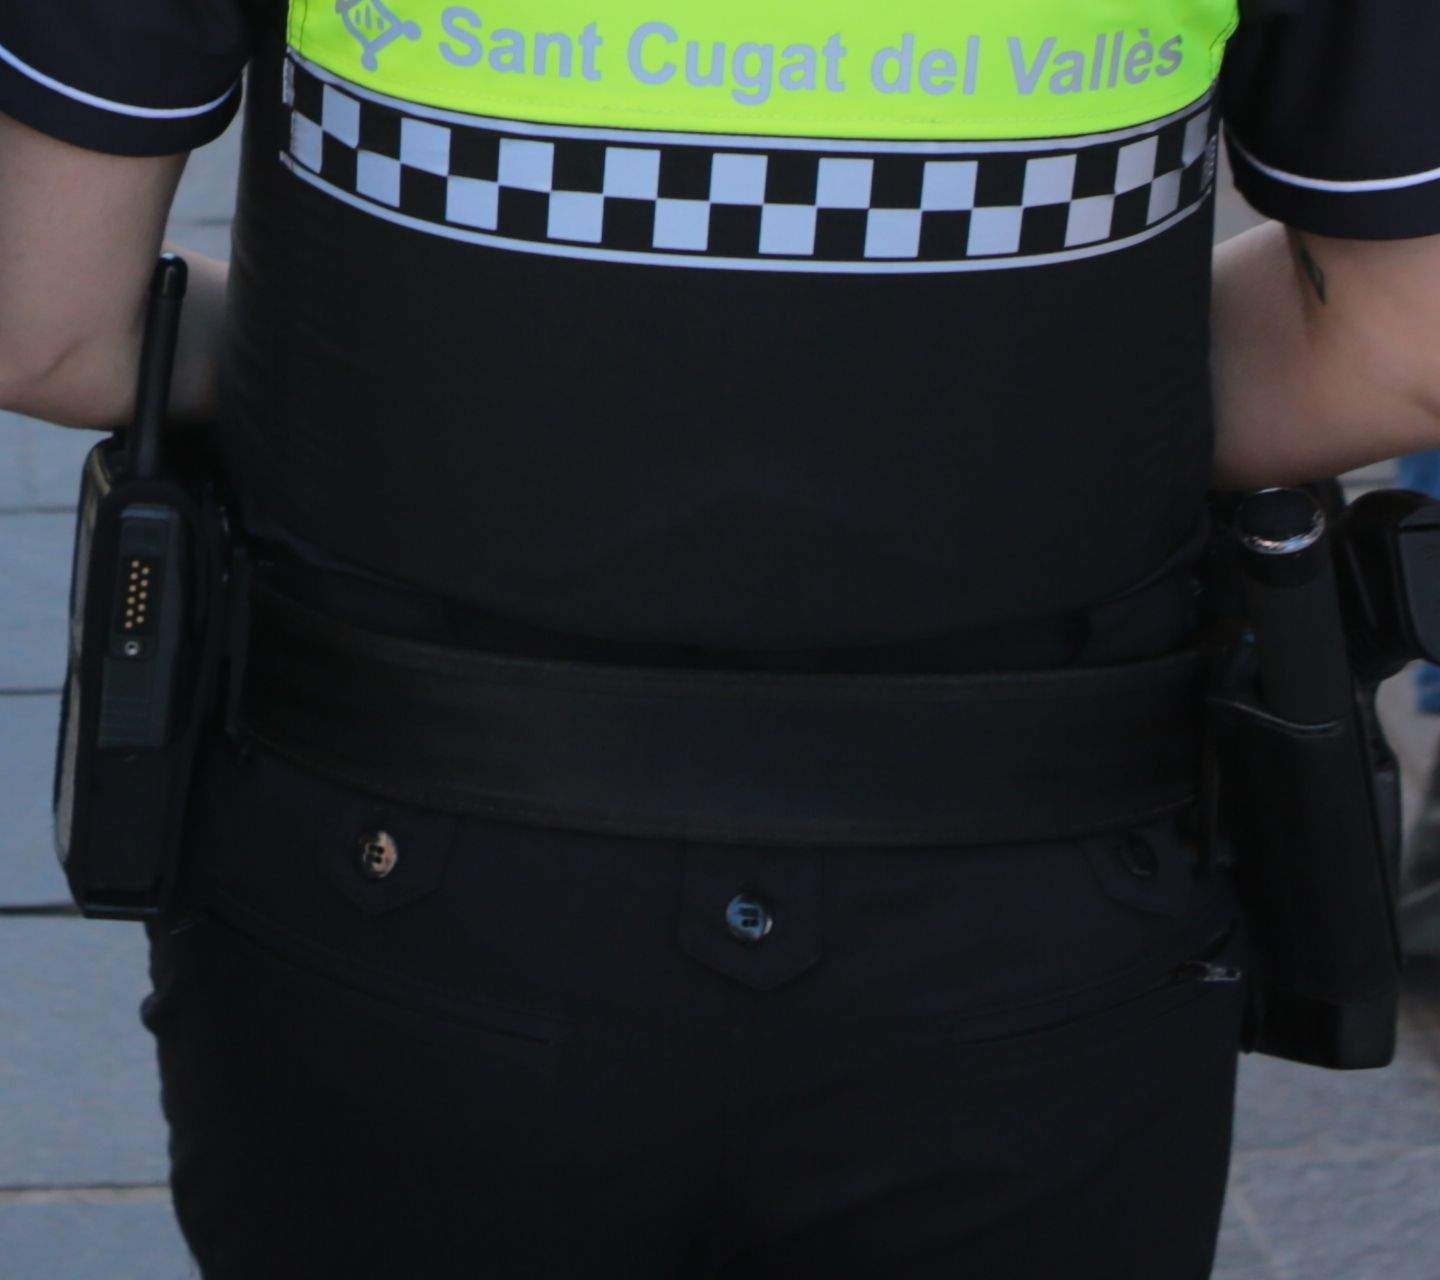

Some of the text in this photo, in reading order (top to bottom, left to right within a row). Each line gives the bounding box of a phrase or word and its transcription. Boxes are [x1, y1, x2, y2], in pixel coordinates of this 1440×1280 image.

[438, 5, 1184, 107] Sant Cugat del Vallès
